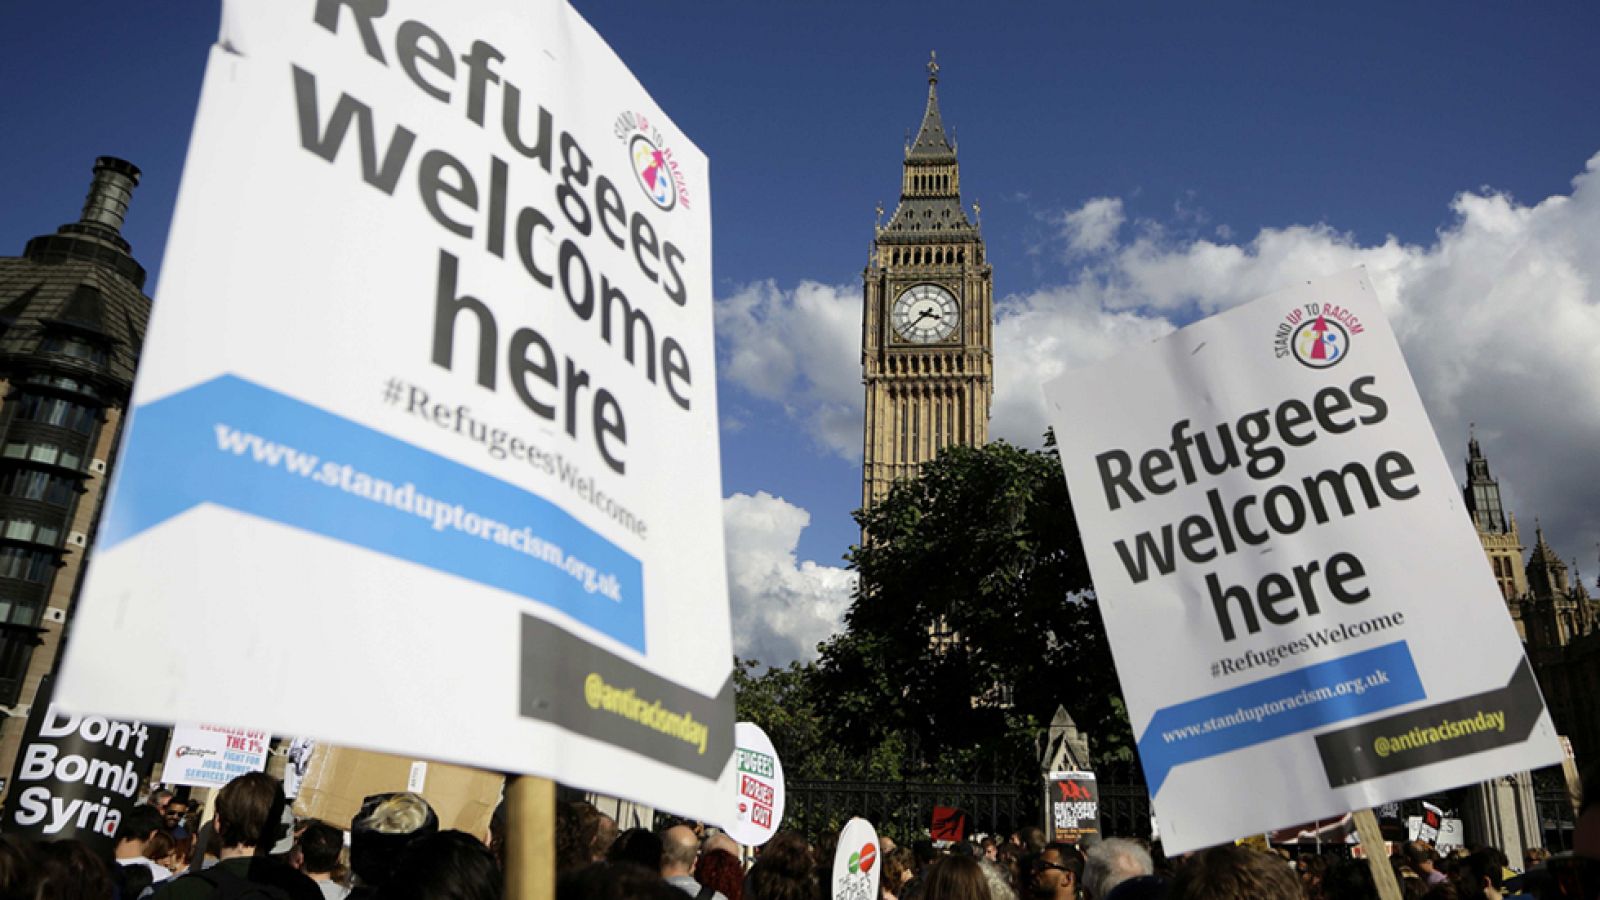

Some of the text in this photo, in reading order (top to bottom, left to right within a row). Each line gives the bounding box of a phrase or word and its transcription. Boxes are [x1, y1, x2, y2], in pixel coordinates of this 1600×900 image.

[291, 62, 691, 411] welcome
[431, 247, 627, 476] here
[1274, 302, 1364, 358] STAND UP TO RACISM
[383, 377, 647, 540] #RefugeesWelcome
[1095, 375, 1389, 511] Refugees
[214, 424, 622, 602] www.standuptoracism.org.uk
[1113, 451, 1421, 584] welcome
[1205, 552, 1371, 642] here
[1210, 610, 1405, 677] #RefugeesWelcome
[39, 703, 149, 758] Don't
[584, 673, 709, 753] @antiracismday
[1162, 669, 1390, 744] www.standuptoracism.org.uk
[1374, 709, 1505, 758] @antiracismday
[19, 743, 138, 798] Bomb
[226, 735, 246, 750] THE
[737, 751, 773, 778] FUGEES
[14, 786, 122, 838] Syria
[752, 804, 771, 828] OUT
